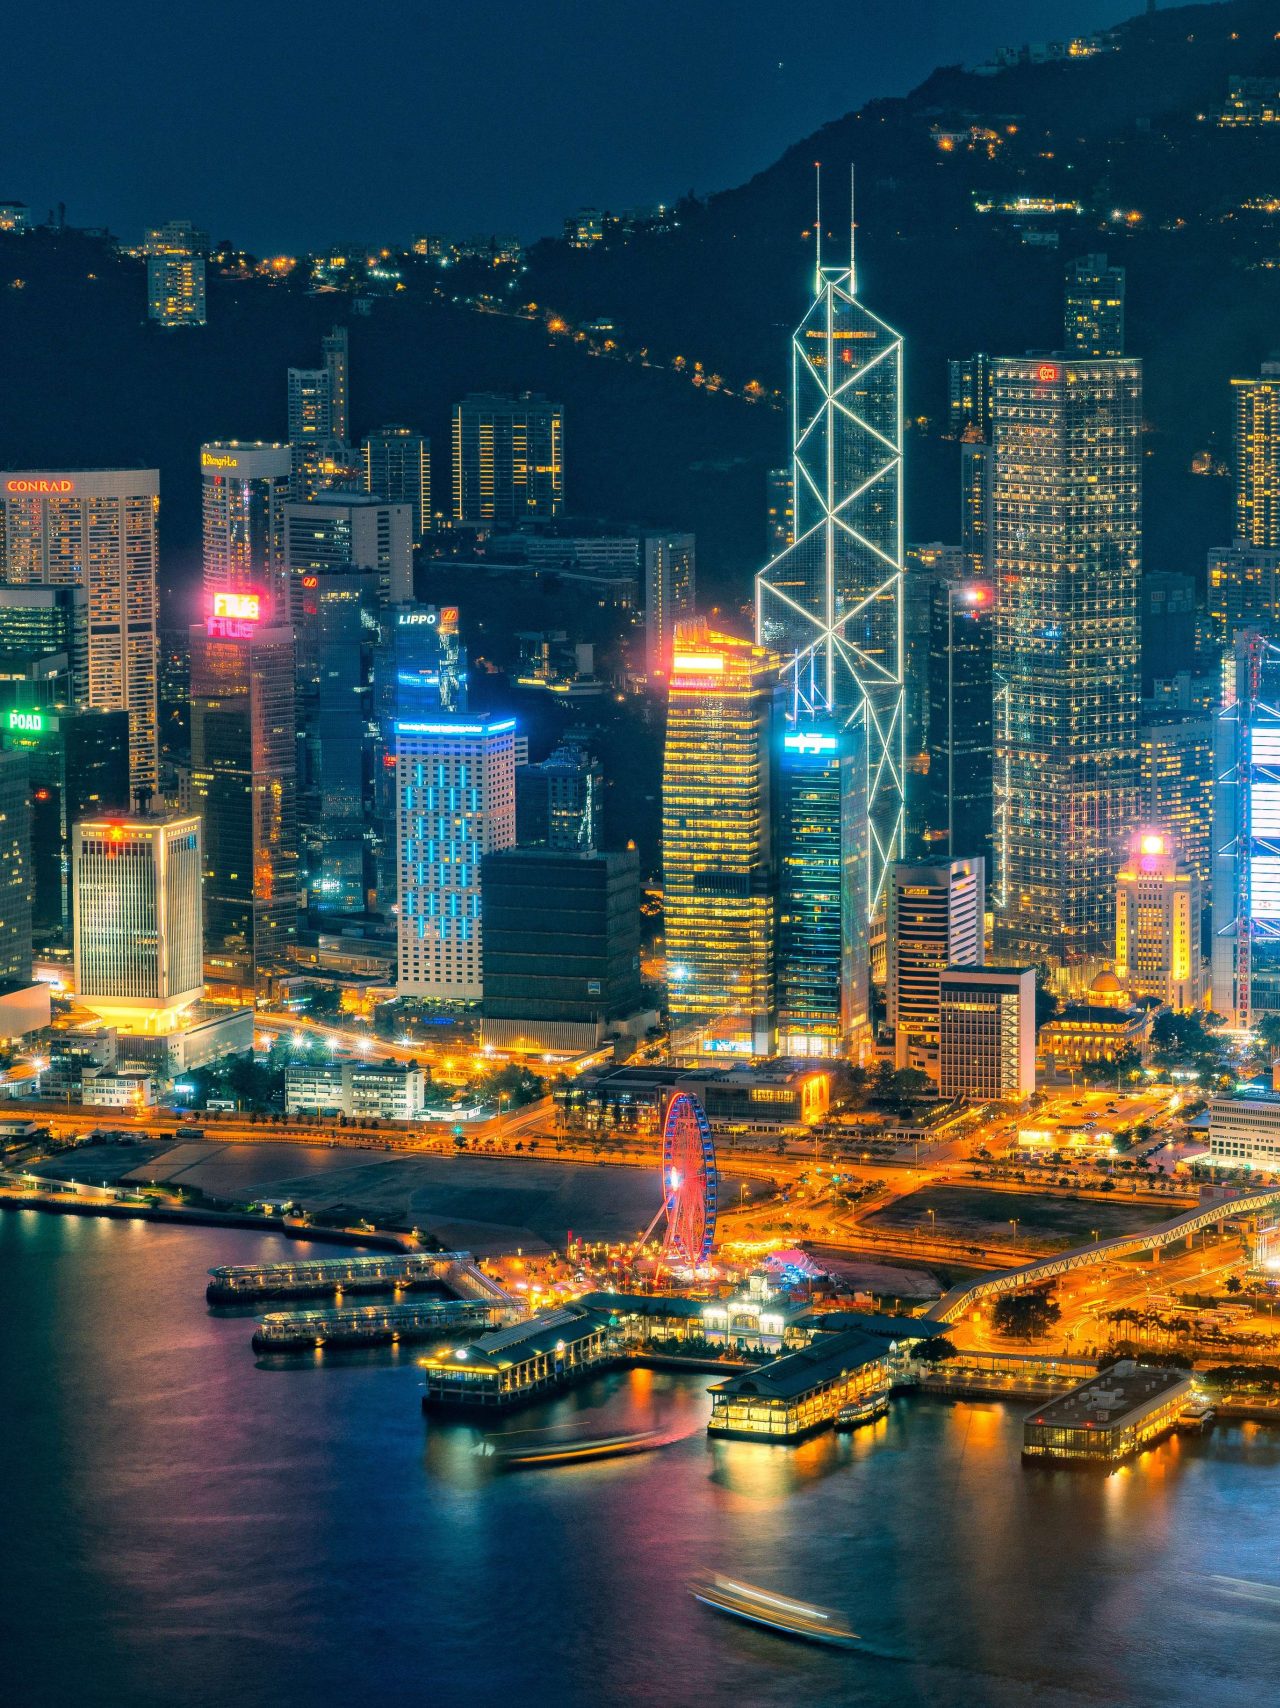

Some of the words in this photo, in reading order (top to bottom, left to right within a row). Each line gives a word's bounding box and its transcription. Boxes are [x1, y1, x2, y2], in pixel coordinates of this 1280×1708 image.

[7, 480, 73, 492] CONRAD
[399, 614, 436, 625] LIPPO
[9, 713, 42, 730] POAD
